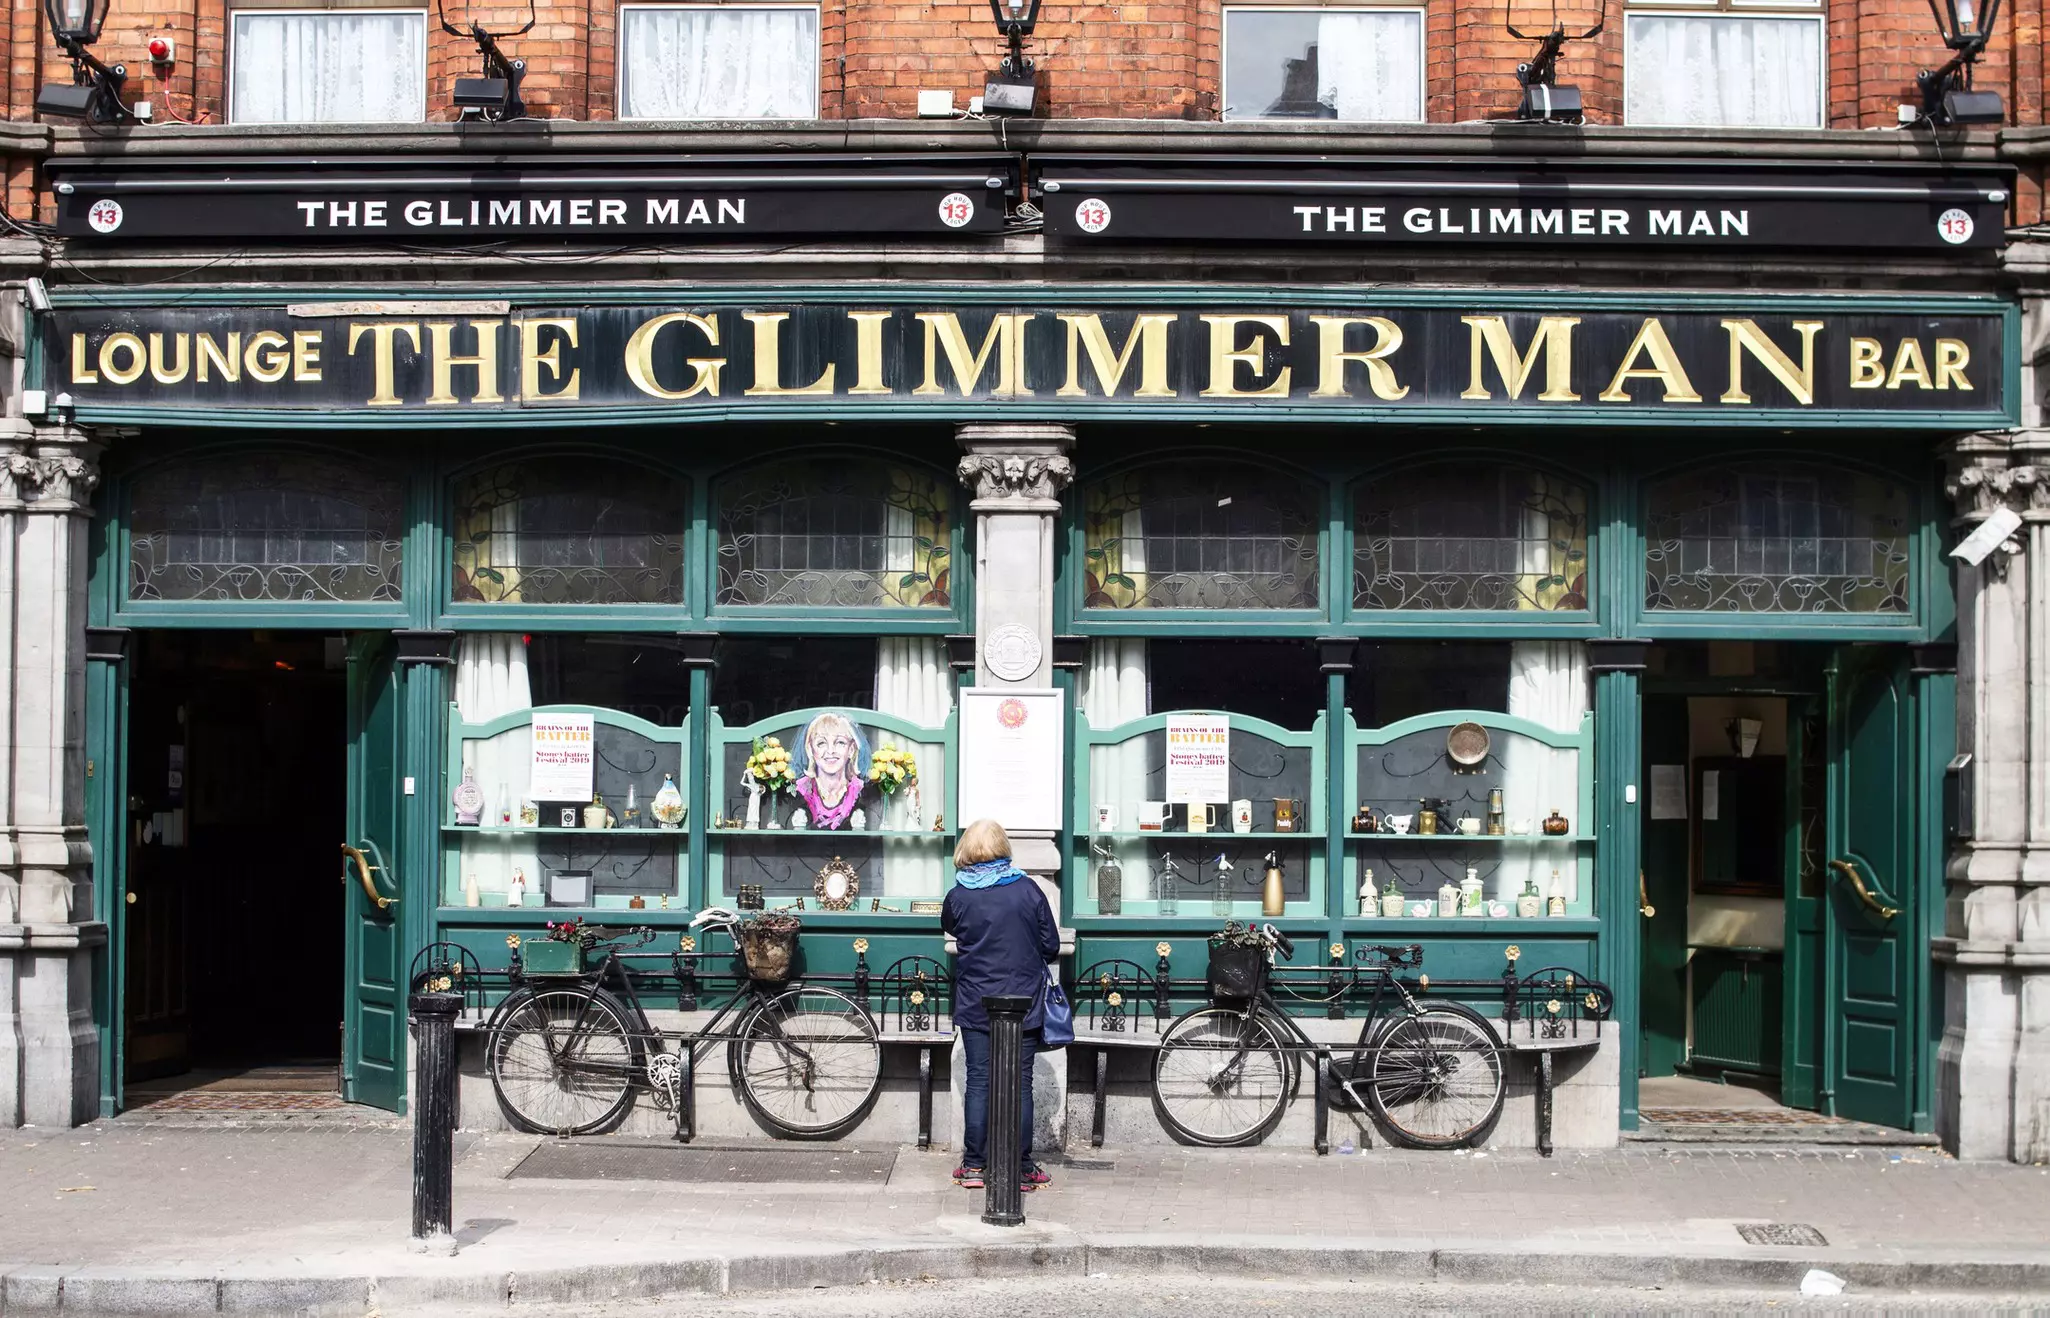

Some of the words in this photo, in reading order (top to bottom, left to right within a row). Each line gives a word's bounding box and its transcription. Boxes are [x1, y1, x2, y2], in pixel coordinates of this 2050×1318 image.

[95, 210, 116, 224] 13
[297, 201, 388, 227] THE
[404, 200, 628, 226] GLIMMER
[646, 198, 746, 225] MAN
[945, 203, 967, 219] 13
[1081, 209, 1104, 224] 13
[1293, 205, 1386, 232] THE
[1402, 207, 1630, 235] GLIMMER
[1648, 209, 1749, 236] MAN
[1945, 220, 1967, 235] 13
[71, 330, 323, 384] LOUNGE
[348, 316, 580, 406] THE
[624, 310, 1409, 401] GLIMMER
[1460, 315, 1824, 404] MAN
[1850, 337, 1974, 391] BAR
[536, 731, 591, 741] BATTER
[1170, 733, 1225, 743] BATTER
